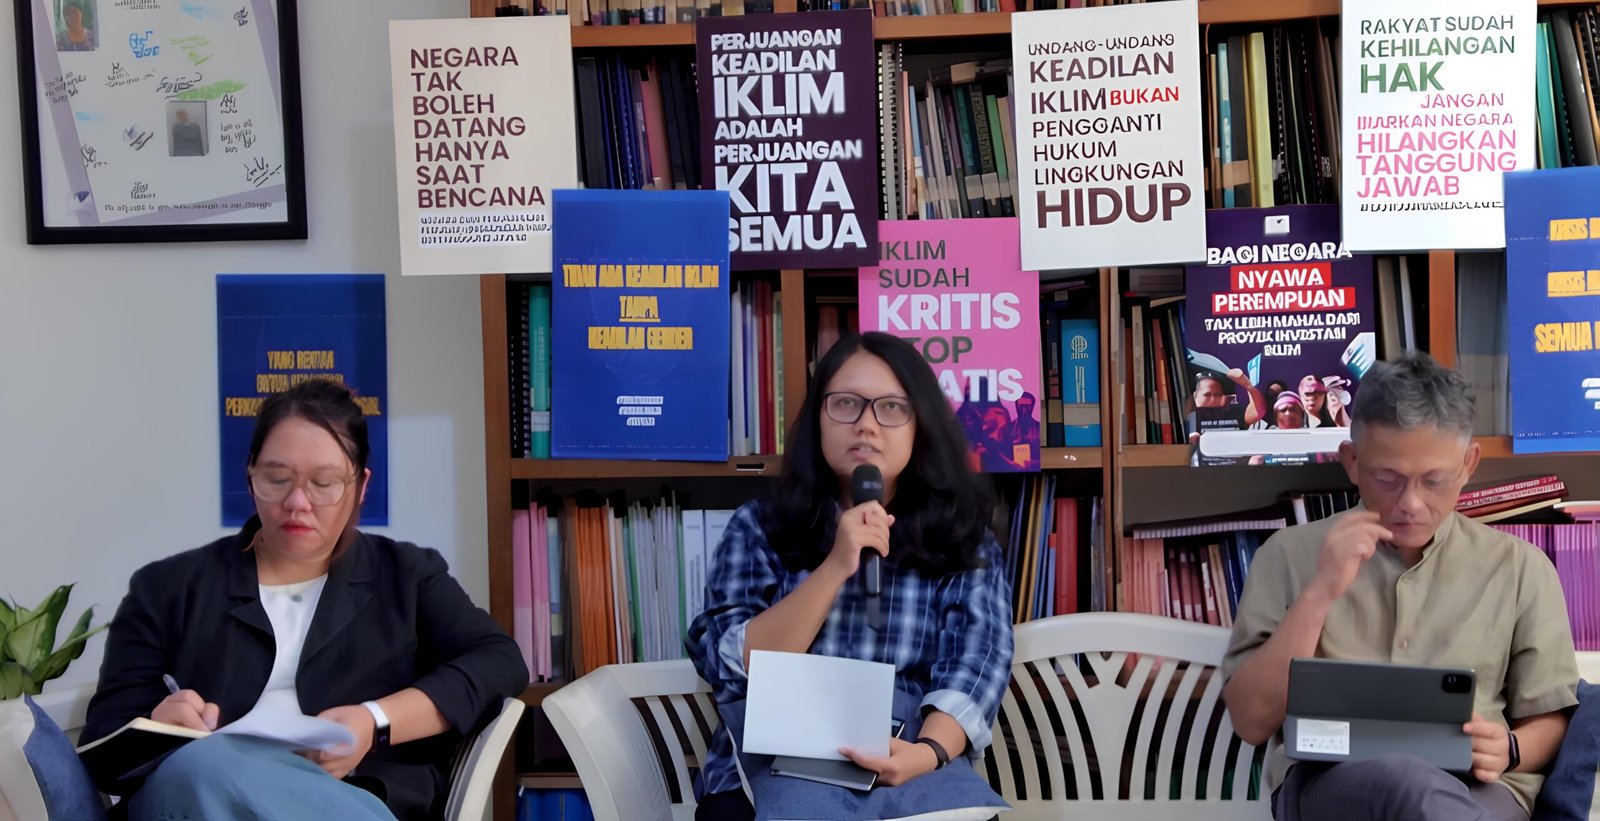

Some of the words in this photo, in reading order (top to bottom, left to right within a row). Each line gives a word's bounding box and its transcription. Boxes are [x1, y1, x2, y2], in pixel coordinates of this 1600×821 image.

[1360, 18, 1441, 35] RAKYAT
[1445, 15, 1514, 32] SUDAH
[711, 28, 842, 51] PERJUANGAN
[1360, 36, 1515, 59] KEHILANGAN
[410, 46, 519, 69] NEGARA
[712, 49, 836, 75] KEADILAN
[1030, 51, 1175, 84] KEADILAN
[411, 71, 463, 92] TAK
[1360, 61, 1446, 94] HAK
[412, 94, 495, 116] BOLEH
[713, 71, 846, 118] IKLIM
[1031, 88, 1107, 115] IKLIM
[1110, 86, 1180, 106] BUKAN
[1420, 93, 1504, 109] JANGAN
[413, 116, 526, 139] DATANG
[714, 118, 803, 140] ADALAH
[1441, 113, 1514, 127] NEGARA
[415, 140, 510, 163] HANYA
[714, 139, 863, 164] PERJUANGAN
[1033, 140, 1117, 162] HUKUM
[1357, 129, 1517, 154] HILANGKAN
[416, 164, 485, 186] SAAT
[1034, 160, 1184, 186] LINGKUNGAN
[1355, 151, 1518, 176] TANGGUNG
[417, 186, 546, 209] BENCANA
[715, 161, 855, 213] KITA
[1356, 175, 1460, 199] JAWAB
[1036, 183, 1192, 229] HIDUP
[879, 240, 946, 261] IKLIM
[878, 267, 970, 289] SUDAH
[1238, 267, 1325, 289] NYAWA
[878, 292, 1021, 332] KRITIS
[1214, 288, 1346, 313] PEREMPUAN
[899, 336, 973, 363] OP
[938, 368, 1025, 403] ATIS
